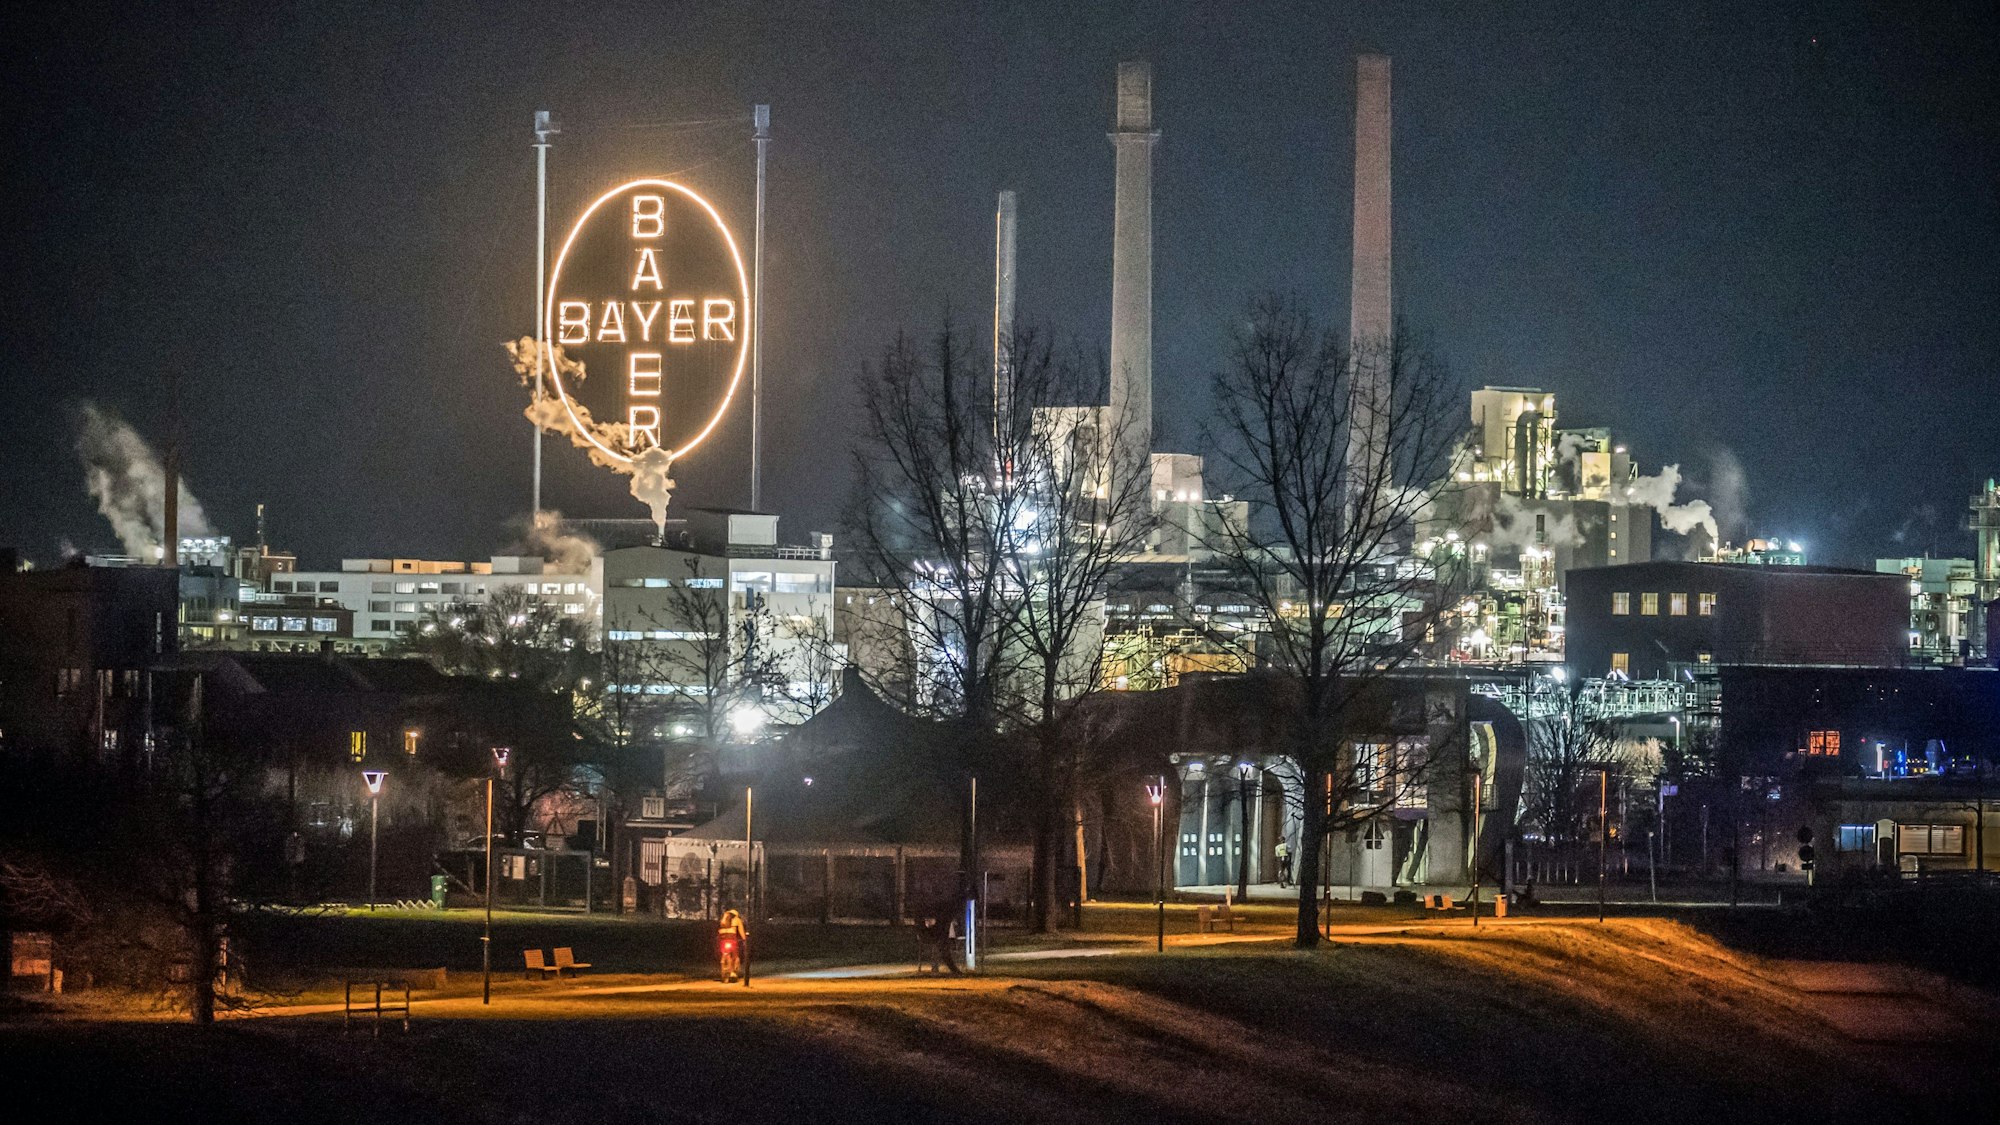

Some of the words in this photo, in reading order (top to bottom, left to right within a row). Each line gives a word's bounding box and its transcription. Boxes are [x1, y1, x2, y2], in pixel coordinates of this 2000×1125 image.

[558, 298, 735, 344] BAYER
[630, 195, 664, 449] BAYER
[645, 799, 661, 815] 701
